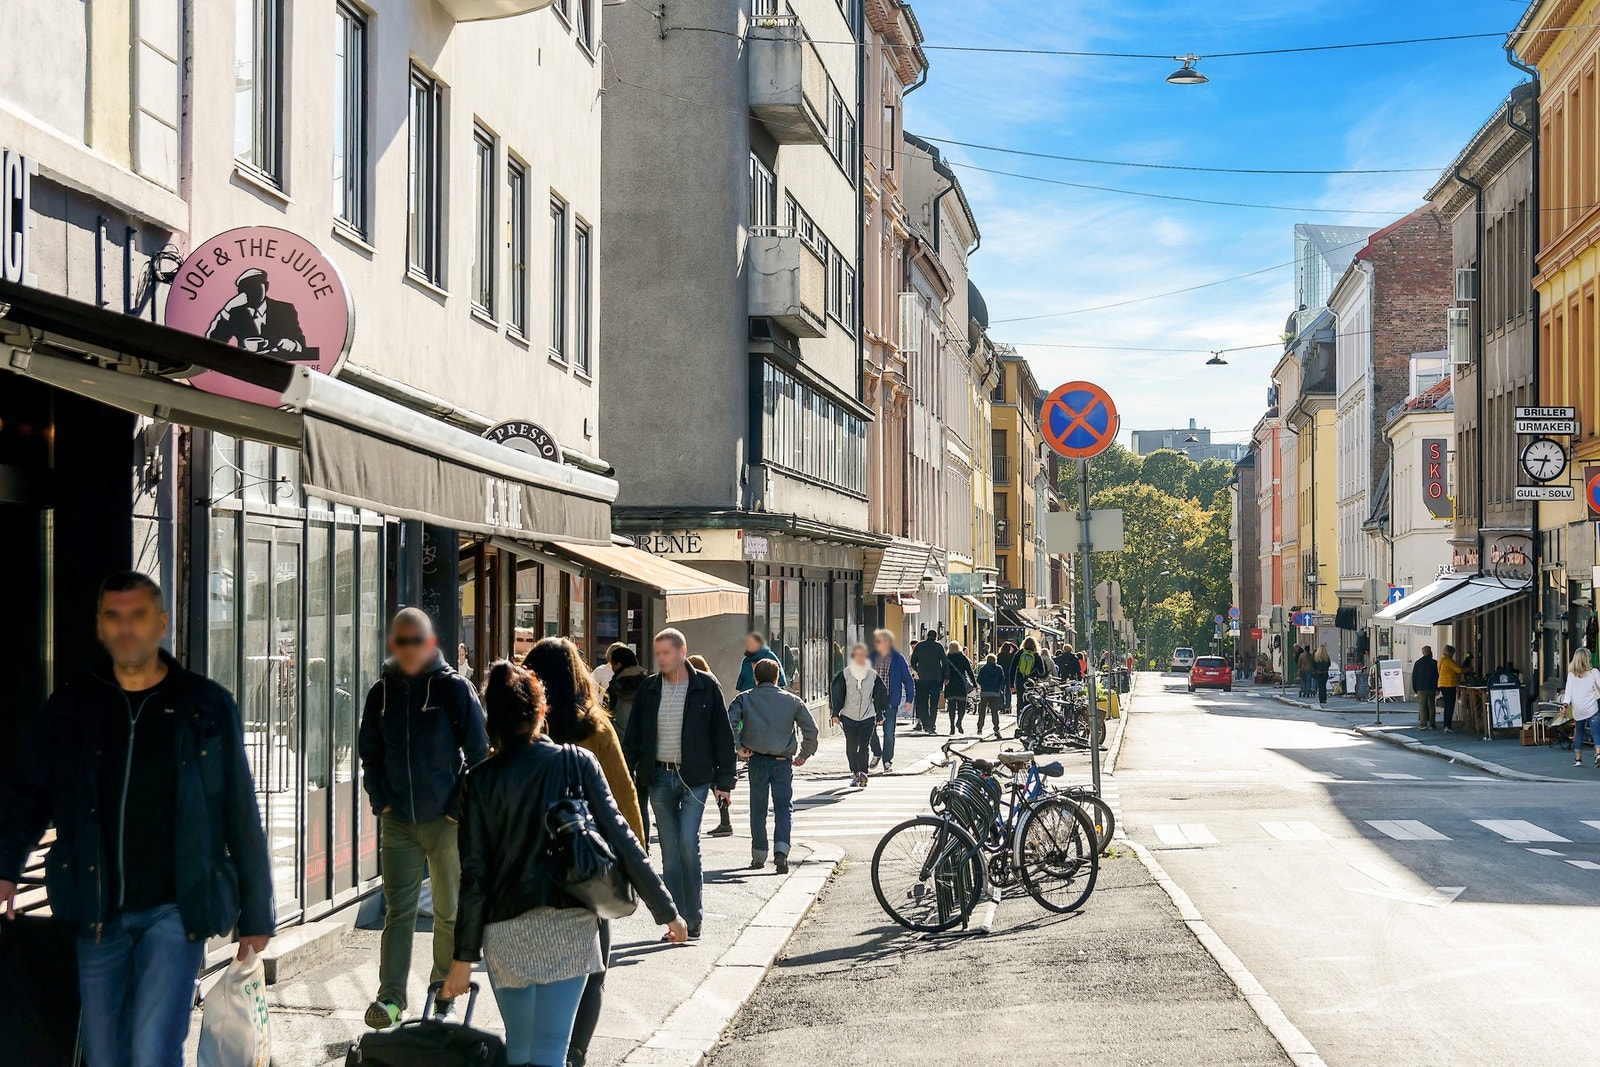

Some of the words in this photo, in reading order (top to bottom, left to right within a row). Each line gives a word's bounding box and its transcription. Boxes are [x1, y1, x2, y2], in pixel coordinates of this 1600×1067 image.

[180, 258, 215, 301] JOE
[213, 247, 232, 266] &
[234, 238, 279, 259] THE
[281, 248, 334, 300] JUICE
[1523, 408, 1567, 417] BRILLER
[1519, 422, 1572, 431] URMAKER
[1428, 442, 1443, 499] SKO
[1516, 489, 1541, 498] GULL
[1548, 489, 1572, 498] SØLV
